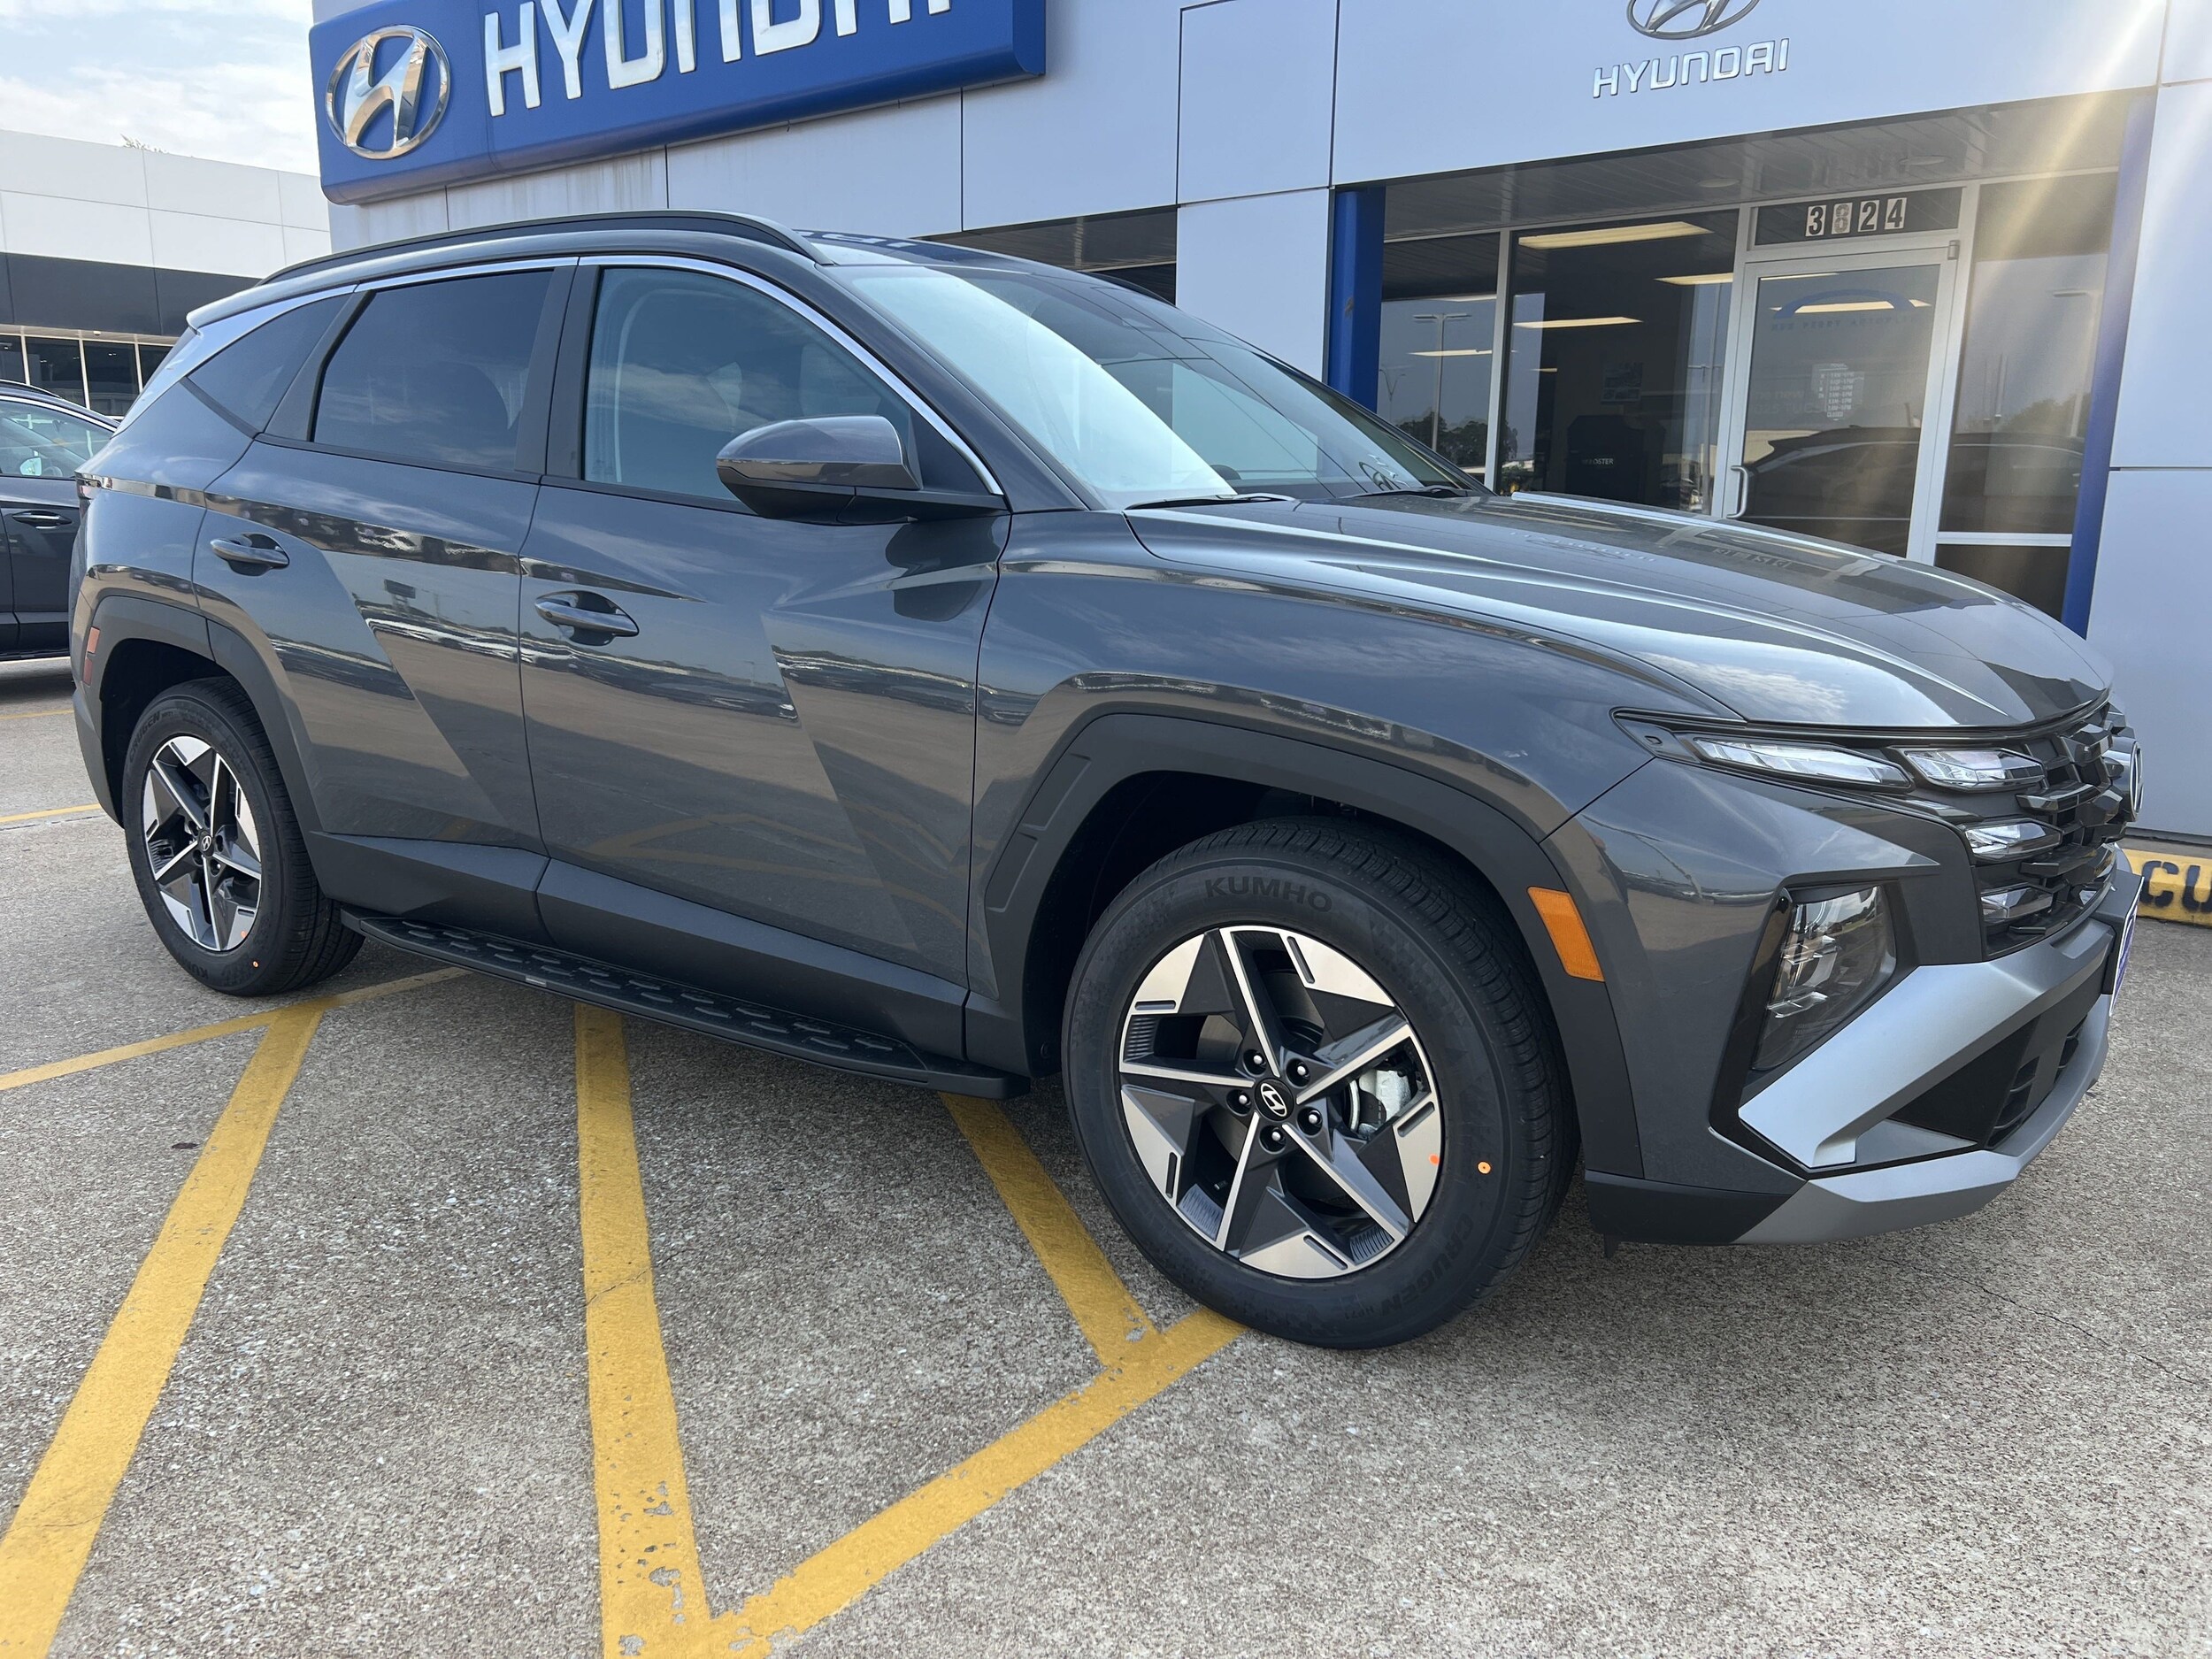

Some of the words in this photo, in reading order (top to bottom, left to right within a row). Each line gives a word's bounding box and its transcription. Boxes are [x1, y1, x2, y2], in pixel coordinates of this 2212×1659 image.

[485, 0, 952, 117] HYUN
[1593, 38, 1790, 98] HYUNDAI
[1204, 876, 1333, 912] KUMHO
